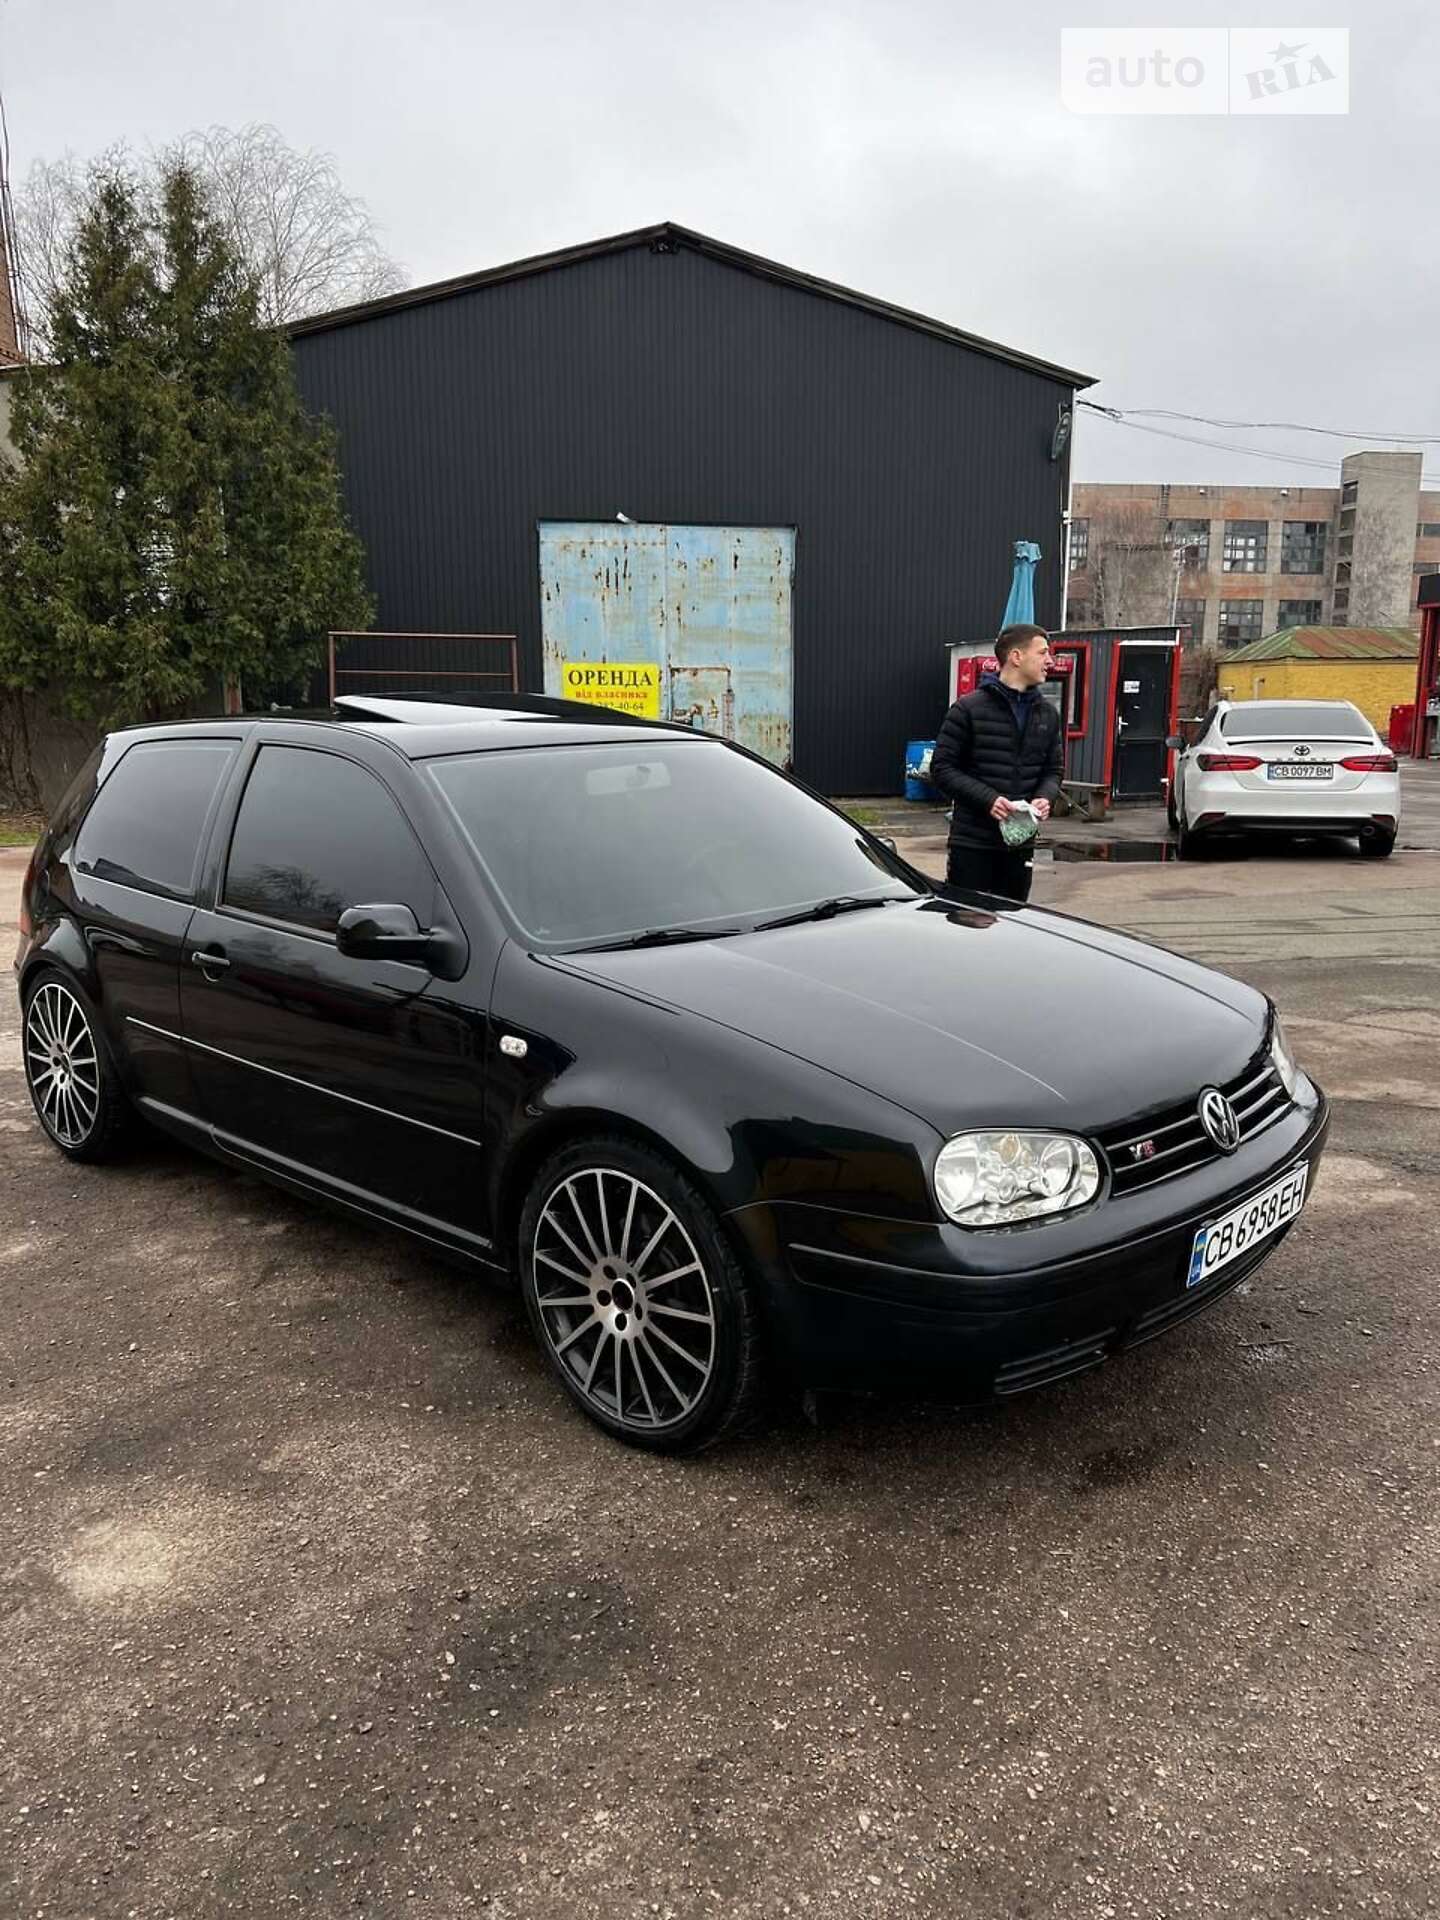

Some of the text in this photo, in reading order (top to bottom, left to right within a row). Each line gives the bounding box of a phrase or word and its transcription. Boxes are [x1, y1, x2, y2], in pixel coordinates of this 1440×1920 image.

[567, 669, 653, 688] ОРЕНДА
[575, 688, 648, 699] від власника
[1274, 766, 1332, 777] CB 0097 BM
[1205, 1175, 1305, 1267] CB 6958 EH
